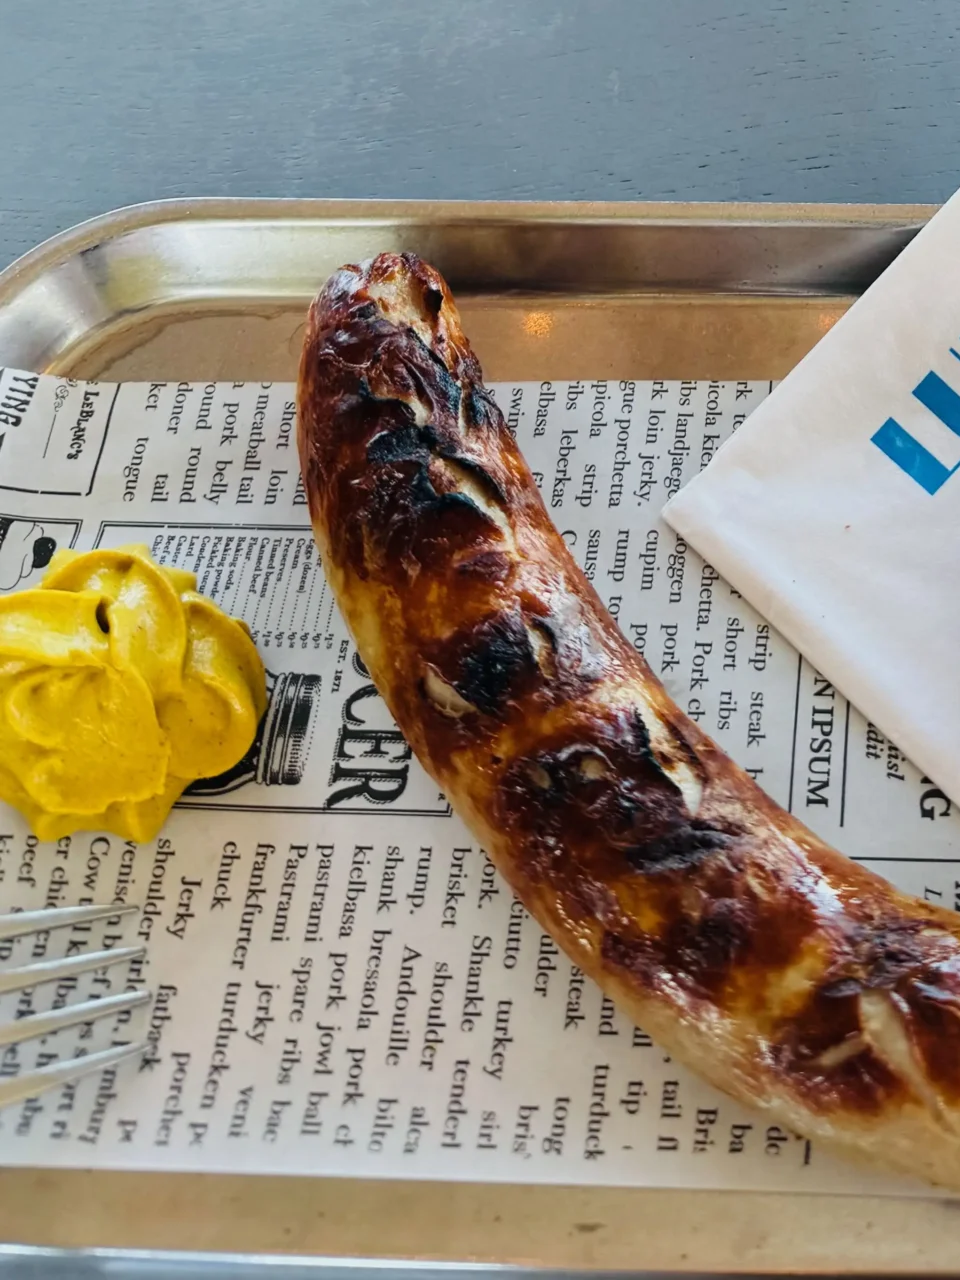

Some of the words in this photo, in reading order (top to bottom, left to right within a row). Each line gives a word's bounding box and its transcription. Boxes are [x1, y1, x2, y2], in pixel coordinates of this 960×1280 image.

[145, 382, 168, 412] ket
[167, 382, 194, 435] doner
[532, 381, 554, 439] elbasa
[618, 380, 637, 414] gue
[219, 402, 240, 447] pork
[243, 394, 269, 471] meatball
[275, 401, 297, 450] short
[645, 409, 667, 445] loin
[122, 437, 150, 502] tongue
[150, 473, 170, 503] tail
[178, 446, 202, 504] round
[202, 460, 233, 506] belly
[263, 469, 288, 505] loin
[551, 429, 579, 508] leberkas
[574, 464, 598, 508] strip
[608, 418, 631, 509] porchetta
[633, 452, 661, 507] jerky.
[235, 476, 254, 505] tail
[162, 535, 176, 558] Beef
[171, 535, 188, 564] Caster
[185, 535, 200, 557] Lard
[206, 536, 223, 568] Pickled
[218, 536, 235, 568] Baking
[230, 536, 247, 569] Baking
[244, 537, 259, 562] Flour
[254, 537, 270, 570] Canned
[266, 537, 282, 569] Tinned
[275, 537, 294, 582] Preserves
[291, 537, 306, 570] Cream
[607, 529, 630, 582] rump
[638, 529, 660, 591] cupim
[223, 570, 238, 591] soda
[247, 571, 263, 595] beef
[259, 570, 274, 599] beans
[295, 561, 314, 594] (dozen)
[695, 558, 720, 632] chetta.
[336, 639, 350, 664] EST.
[660, 623, 680, 674] pork
[689, 640, 713, 692] Pork
[722, 617, 745, 671] short
[748, 623, 773, 672] strip
[330, 669, 344, 694] 1871
[717, 690, 738, 730] ribs
[746, 691, 767, 748] steak
[805, 705, 835, 808] IPSUM
[83, 836, 111, 891] Cow
[137, 838, 176, 942] shoulder
[210, 841, 241, 911] chuck
[376, 845, 405, 915] shank
[406, 846, 433, 915] rump.
[441, 847, 473, 928] brisket
[165, 876, 203, 940] Jerky
[231, 842, 276, 970] frankfurter
[270, 843, 309, 942] Pastrami
[304, 843, 335, 942] pastrami
[338, 845, 374, 939] kielbasa
[289, 957, 313, 1023] spare
[325, 952, 348, 1010] pork
[356, 929, 393, 1031] bresaola
[385, 944, 423, 1066] Andouille
[460, 935, 492, 1032] Shankle
[563, 965, 586, 1031] steak
[244, 980, 281, 1046] jerky
[419, 961, 454, 1072] shoulder
[199, 982, 242, 1109] turducken
[277, 1038, 302, 1085] ribs
[313, 1021, 342, 1075] jowl
[482, 1000, 514, 1081] turkey
[341, 1048, 366, 1107] pork
[619, 1080, 648, 1115] tip
[660, 1080, 682, 1118] tail
[300, 1091, 330, 1135] ball
[476, 1110, 501, 1150] sirl
[542, 1097, 571, 1156] tong
